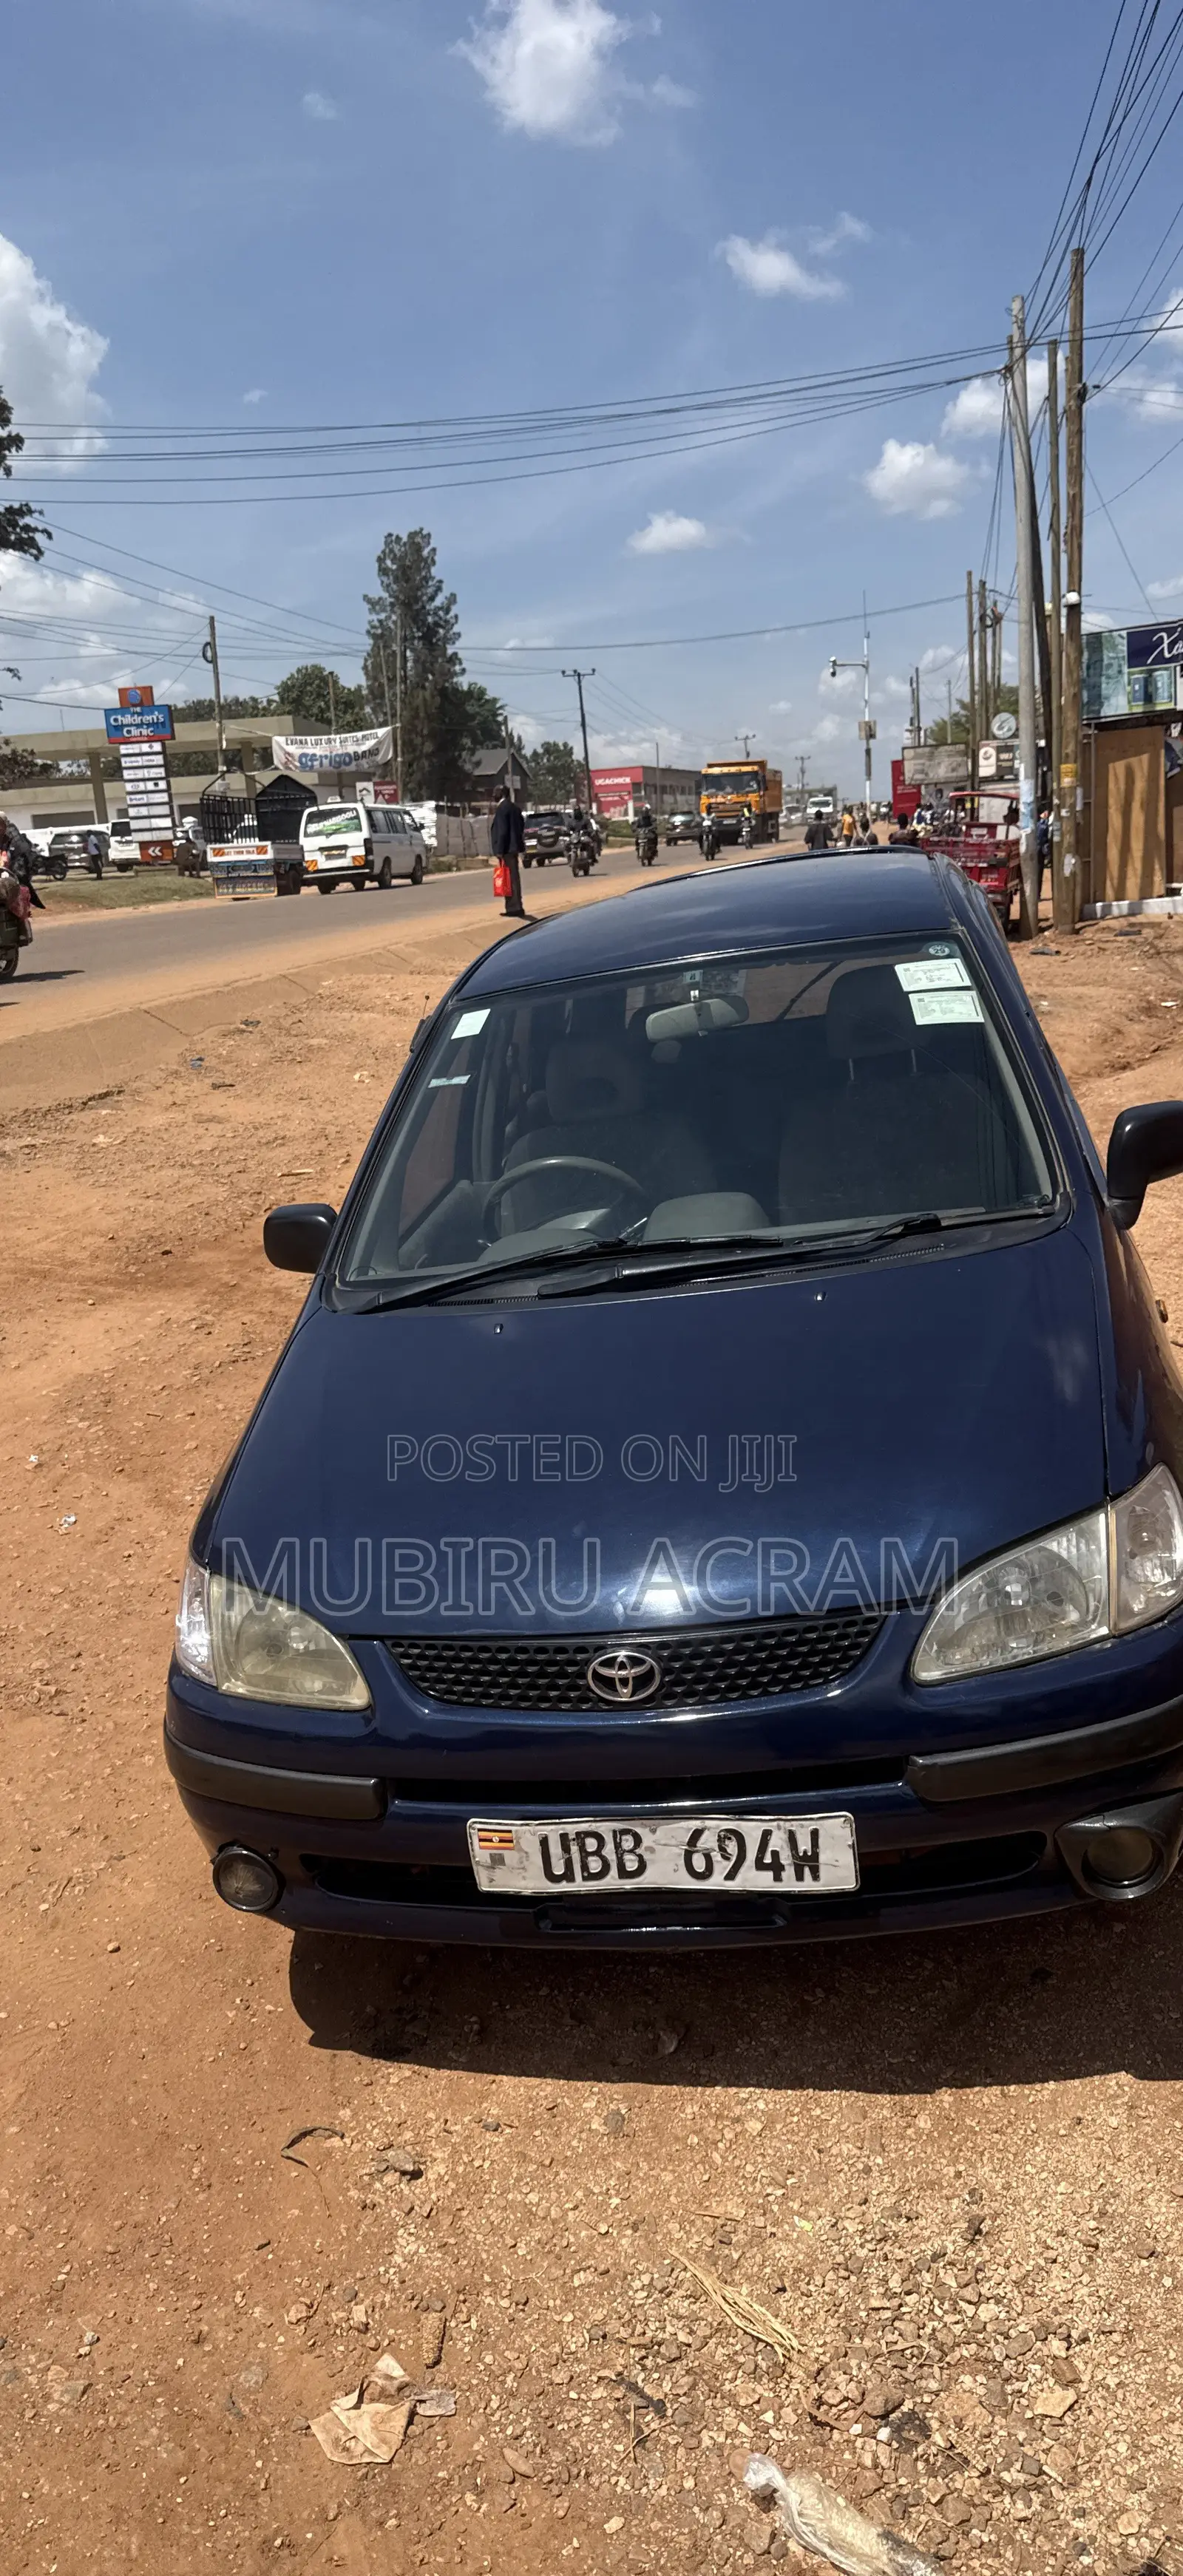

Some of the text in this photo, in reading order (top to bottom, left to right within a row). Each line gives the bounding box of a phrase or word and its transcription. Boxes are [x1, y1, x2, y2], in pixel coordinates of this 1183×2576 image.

[110, 711, 164, 726] Children's
[123, 725, 155, 738] Clinic
[311, 737, 337, 746] LUXURY
[594, 777, 631, 786] UGACHICK
[538, 1826, 821, 1884] UBB 694W
